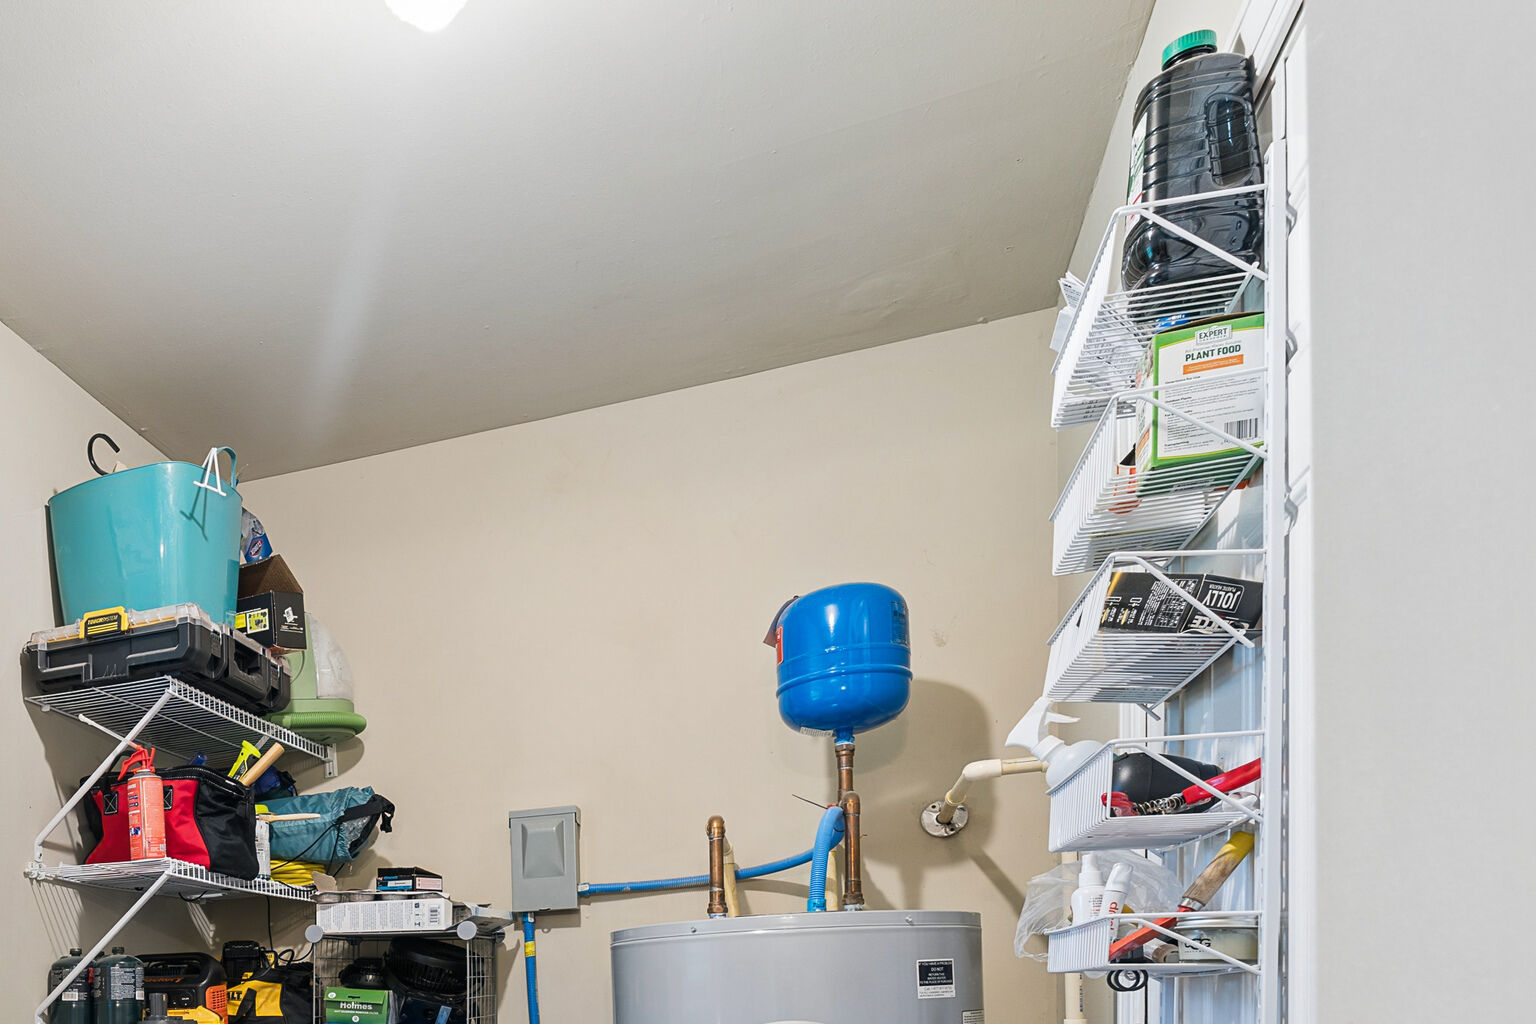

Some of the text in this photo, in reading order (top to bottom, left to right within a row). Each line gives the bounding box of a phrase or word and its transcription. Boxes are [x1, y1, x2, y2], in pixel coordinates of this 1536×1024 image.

[1198, 328, 1228, 339] EXPERT
[1185, 344, 1241, 362] PLANT FOOD
[1202, 590, 1241, 609] JOLLY
[340, 1001, 373, 1010] Holmes
